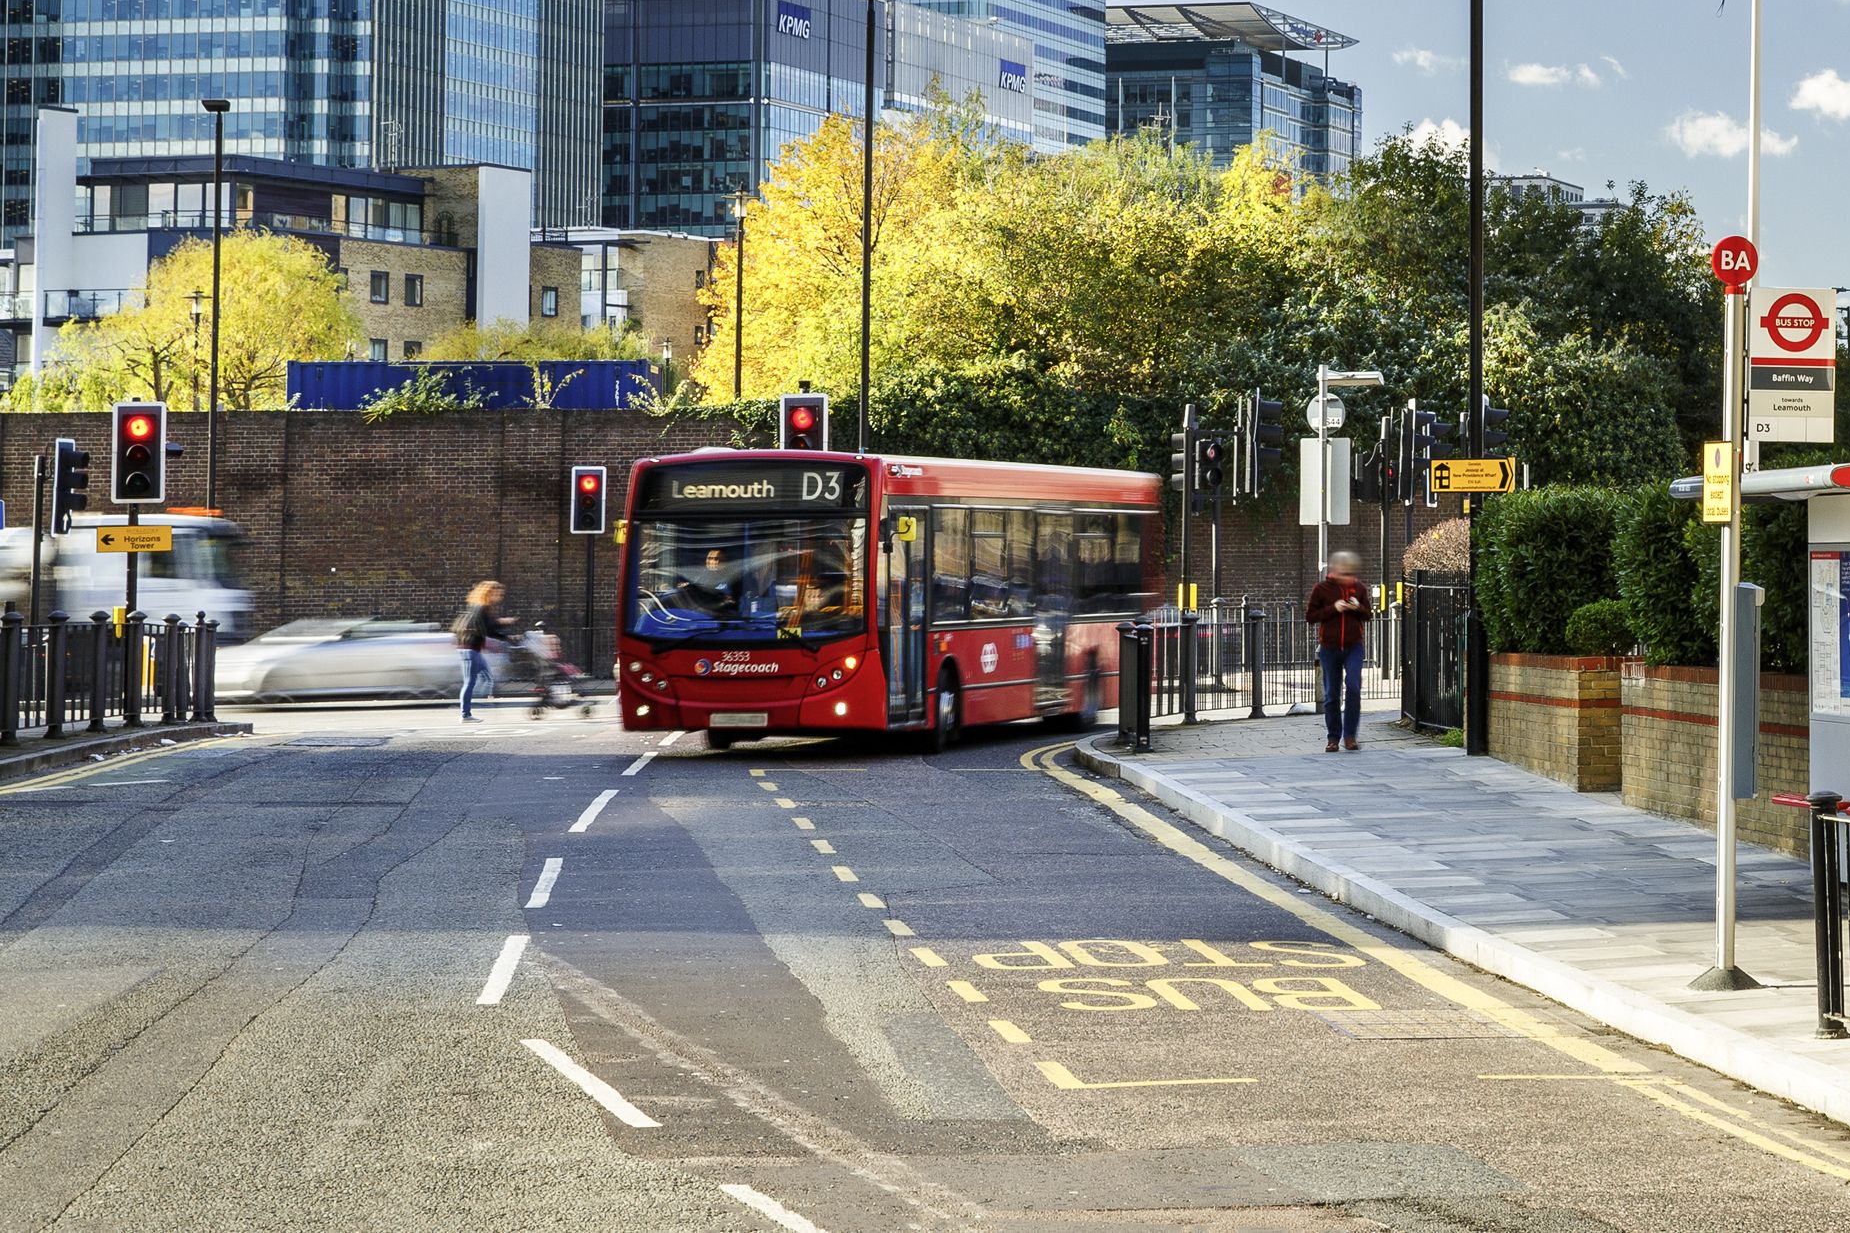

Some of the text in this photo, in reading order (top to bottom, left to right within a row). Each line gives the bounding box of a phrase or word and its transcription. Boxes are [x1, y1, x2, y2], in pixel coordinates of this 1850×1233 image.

[778, 14, 811, 40] KPMG
[1000, 70, 1026, 94] KPMG
[1720, 249, 1752, 271] BA
[1775, 318, 1815, 327] BUS STOP
[1772, 373, 1814, 384] Baffin Way
[1773, 404, 1812, 412] Leamouth
[1756, 423, 1771, 433] D3
[671, 471, 843, 501] Leamouth D3
[123, 535, 161, 543] Horizons
[721, 650, 751, 662] 36353
[712, 660, 779, 676] Stagecoach
[972, 938, 1367, 971] STOP
[1037, 976, 1383, 1012] BUS
